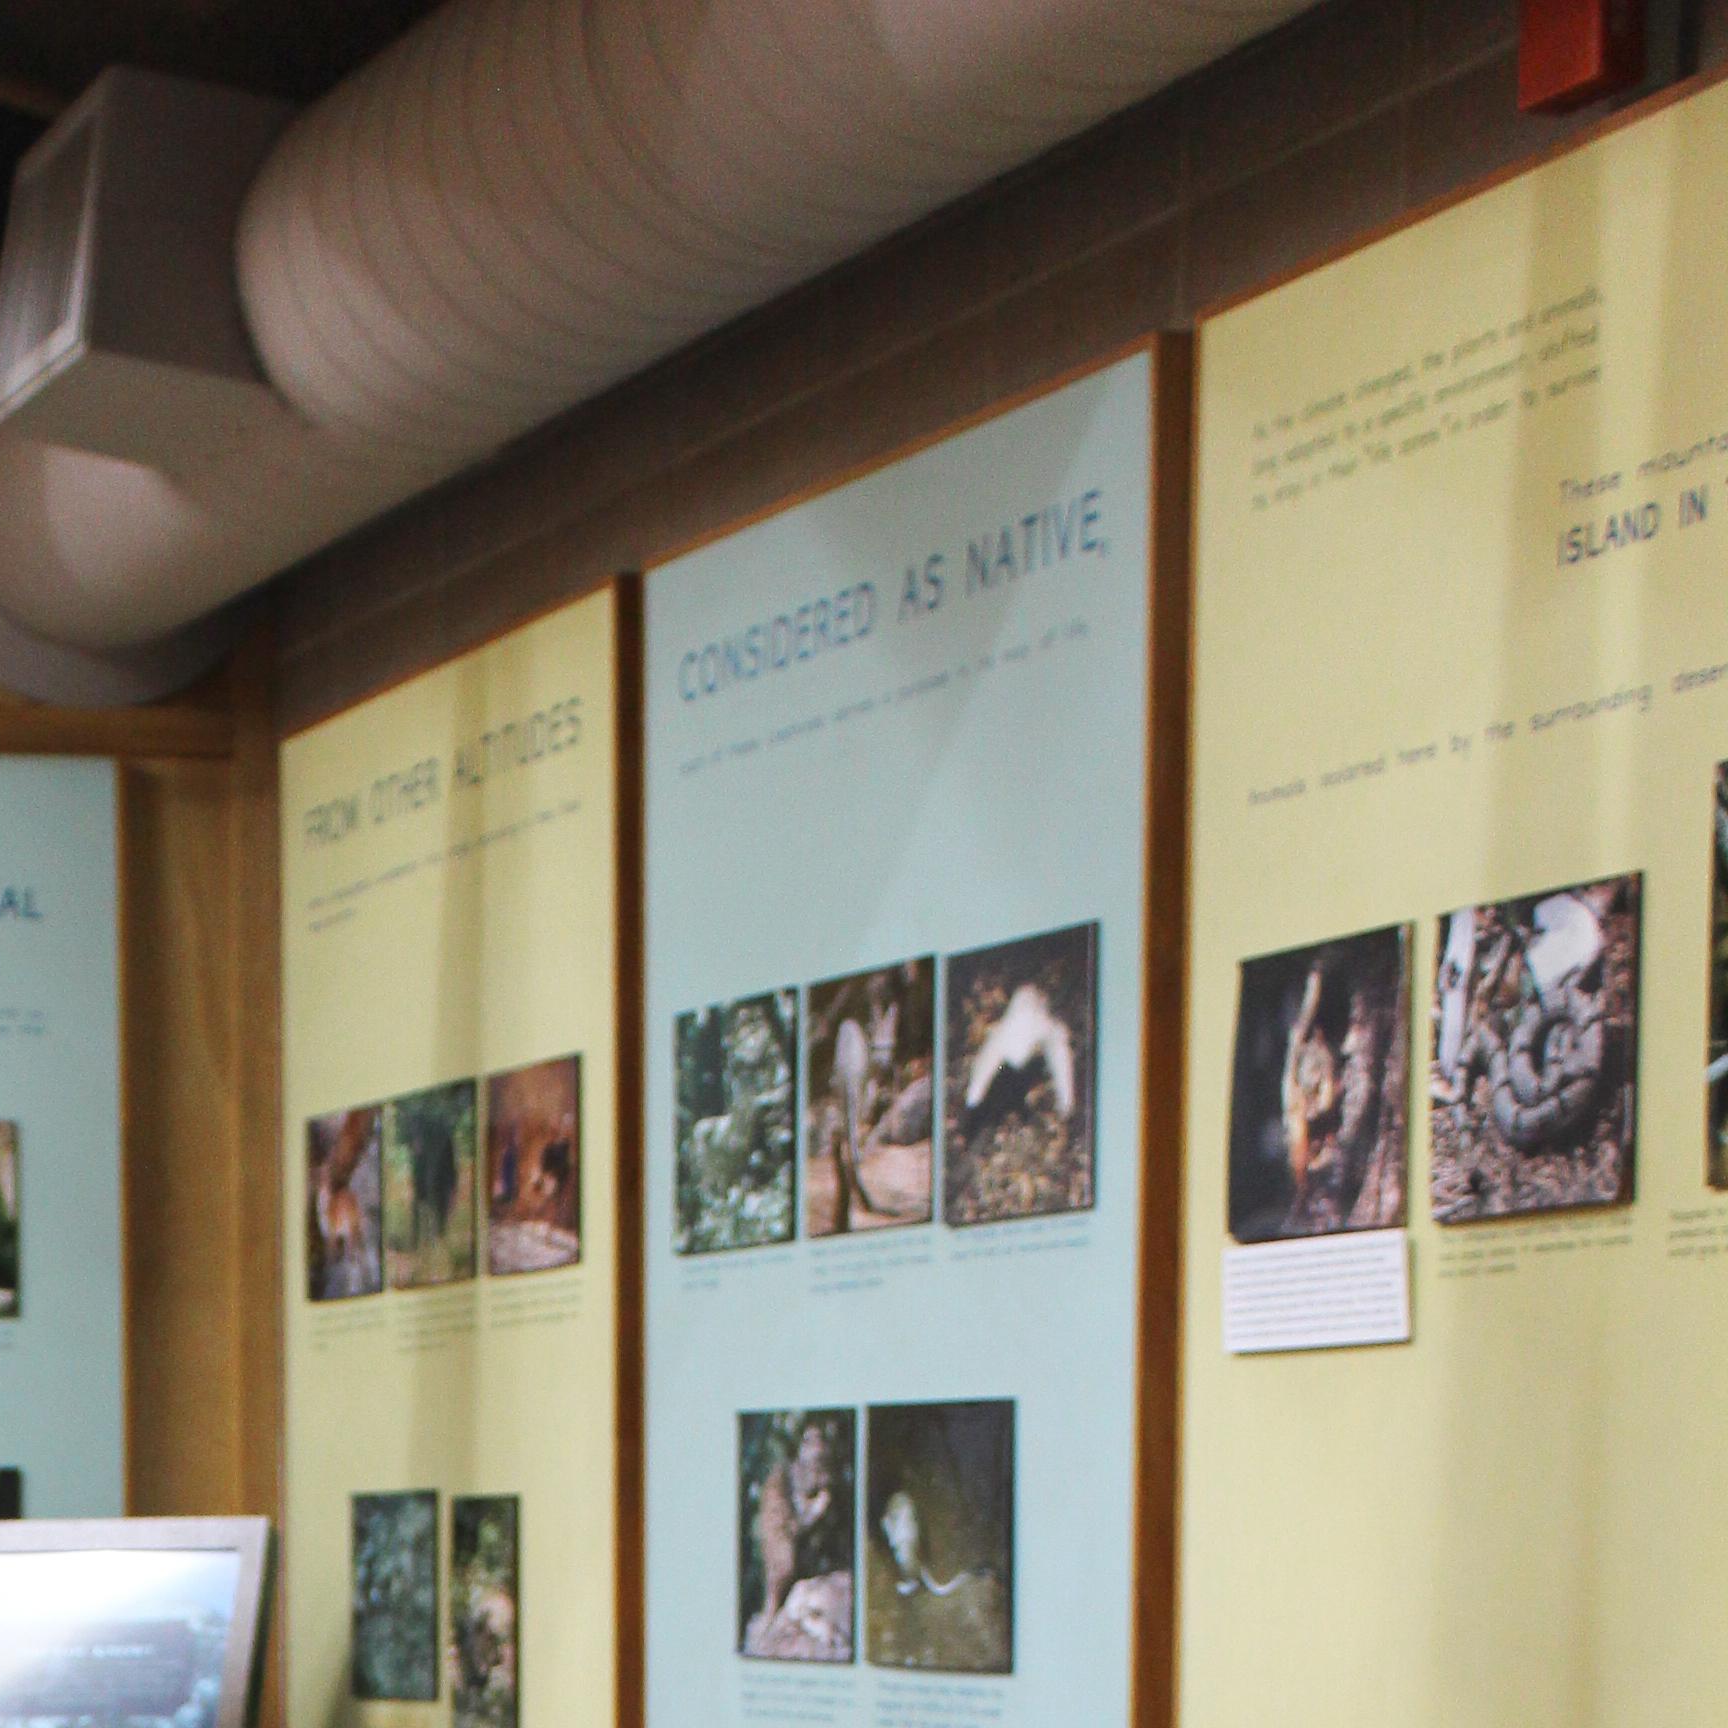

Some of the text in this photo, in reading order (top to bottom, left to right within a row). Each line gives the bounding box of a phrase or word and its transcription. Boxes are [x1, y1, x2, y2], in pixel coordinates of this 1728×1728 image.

[1557, 484, 1709, 569] ISLAND IN
[678, 581, 876, 704] CONSIDERED
[896, 553, 945, 624] AS
